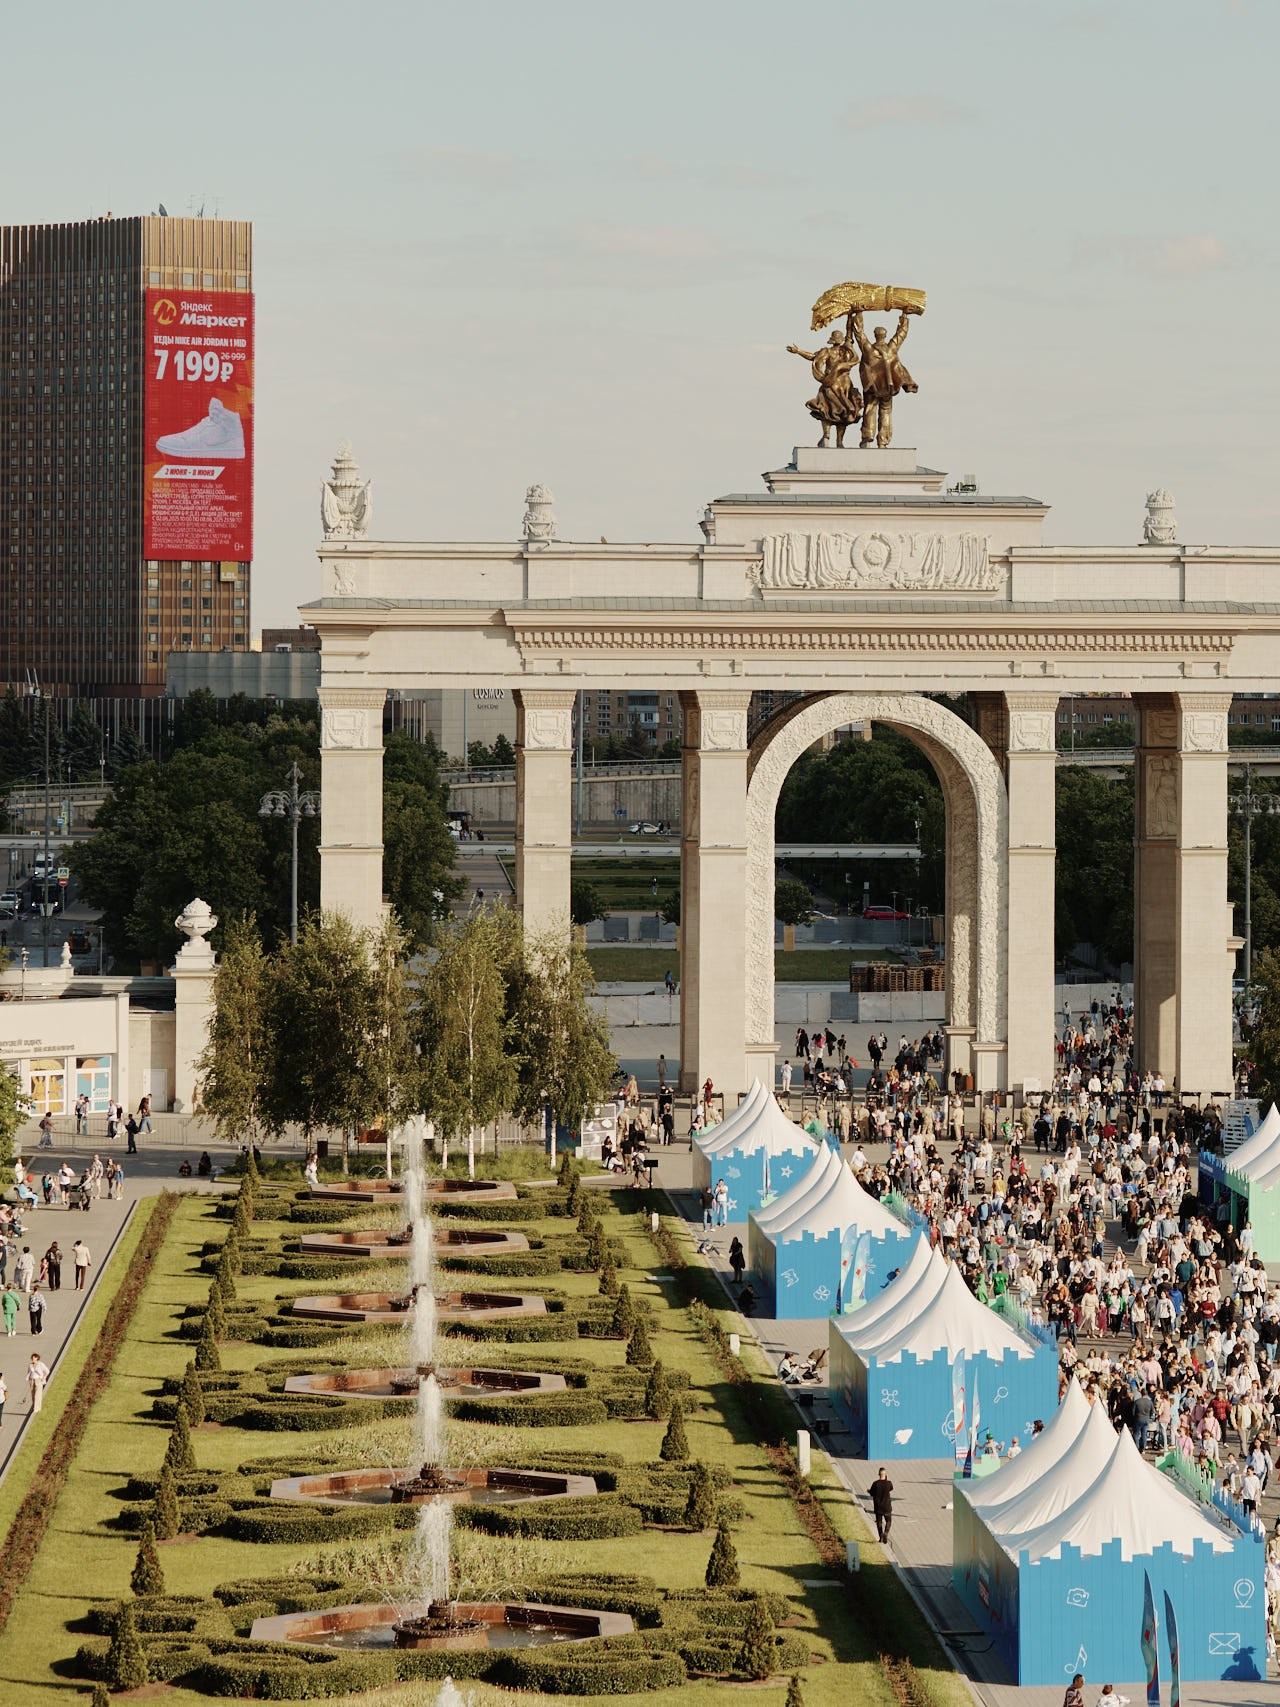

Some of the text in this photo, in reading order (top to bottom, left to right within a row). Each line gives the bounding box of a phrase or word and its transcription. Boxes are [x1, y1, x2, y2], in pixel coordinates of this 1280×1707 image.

[180, 301, 213, 312] Яндекс
[180, 313, 247, 328] Маркет
[153, 335, 247, 348] КЕДЫ NIKE AIR JORDAN 1 MID
[154, 349, 169, 380] 7
